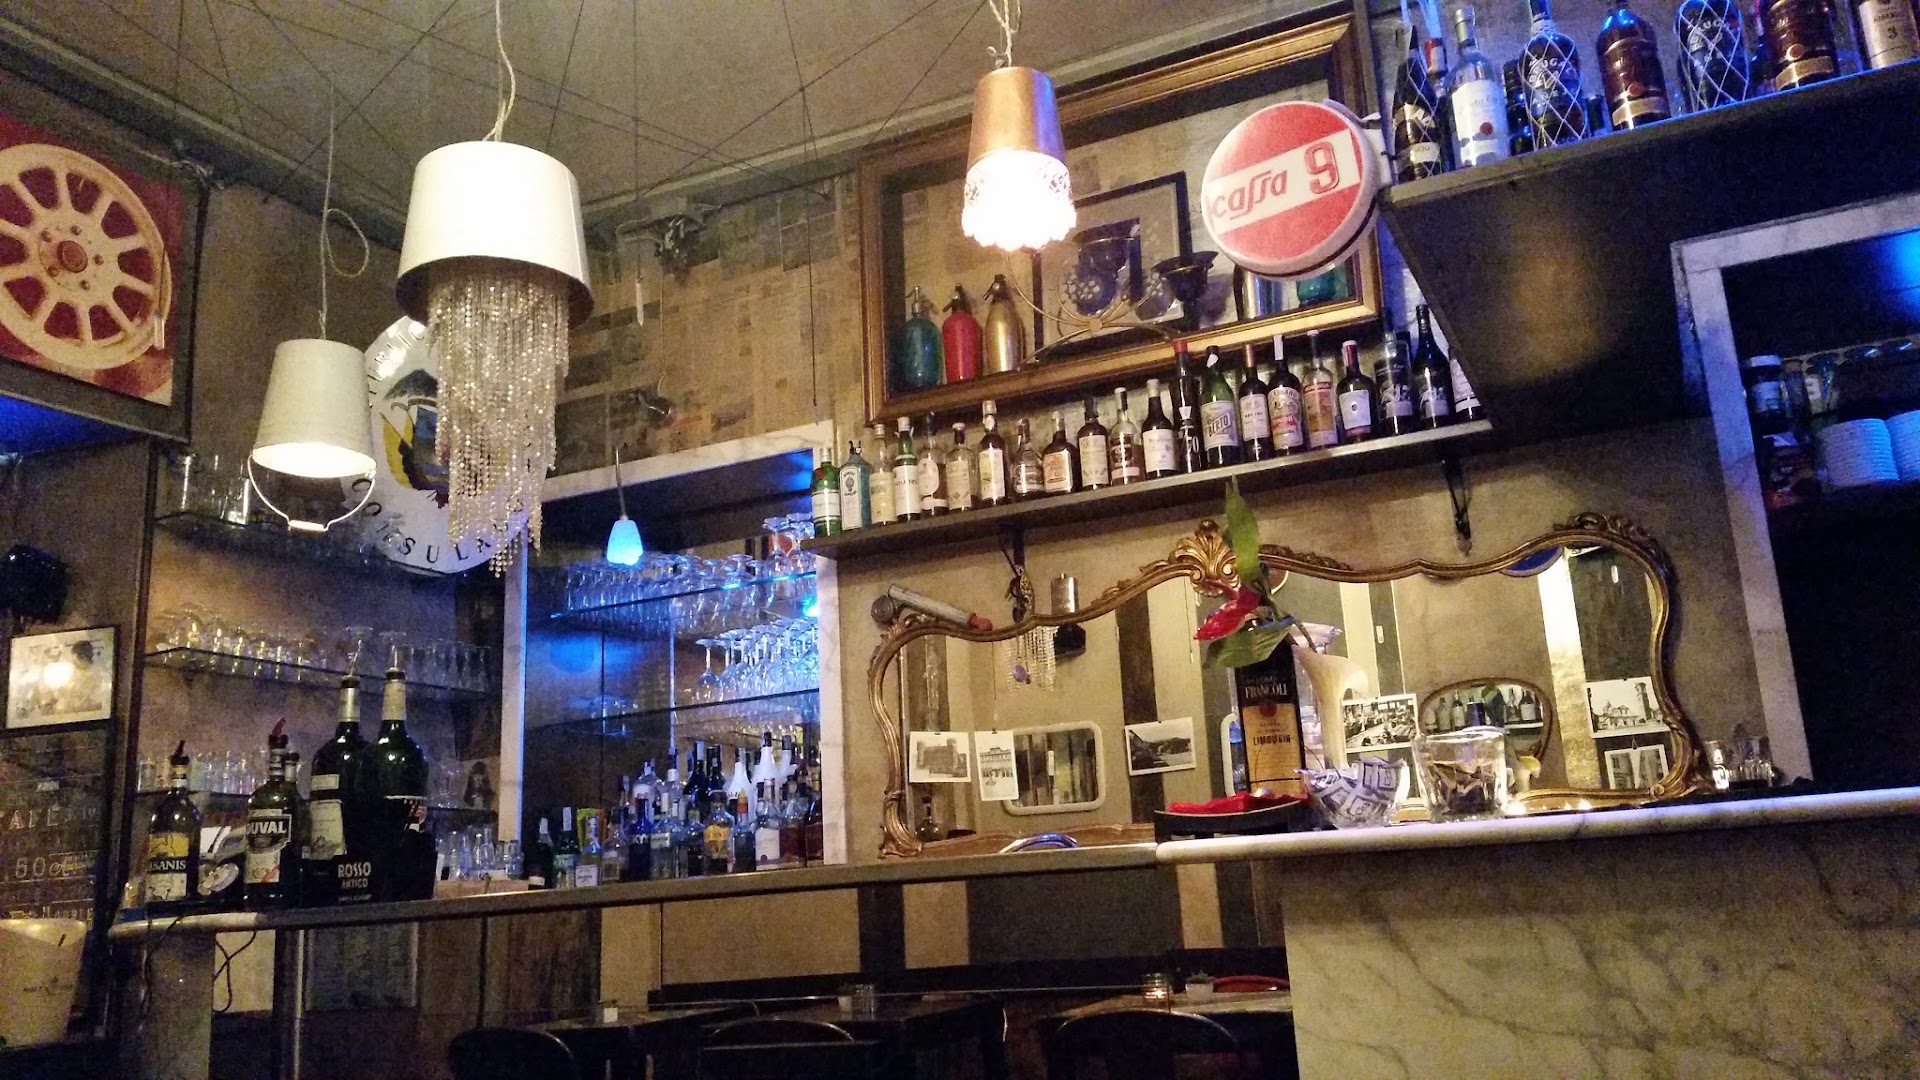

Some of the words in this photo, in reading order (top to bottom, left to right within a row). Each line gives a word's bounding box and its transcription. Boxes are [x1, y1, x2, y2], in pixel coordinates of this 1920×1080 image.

[1304, 141, 1340, 195] 9
[1244, 682, 1288, 699] FRANCOLI
[337, 861, 372, 879] ROSSO
